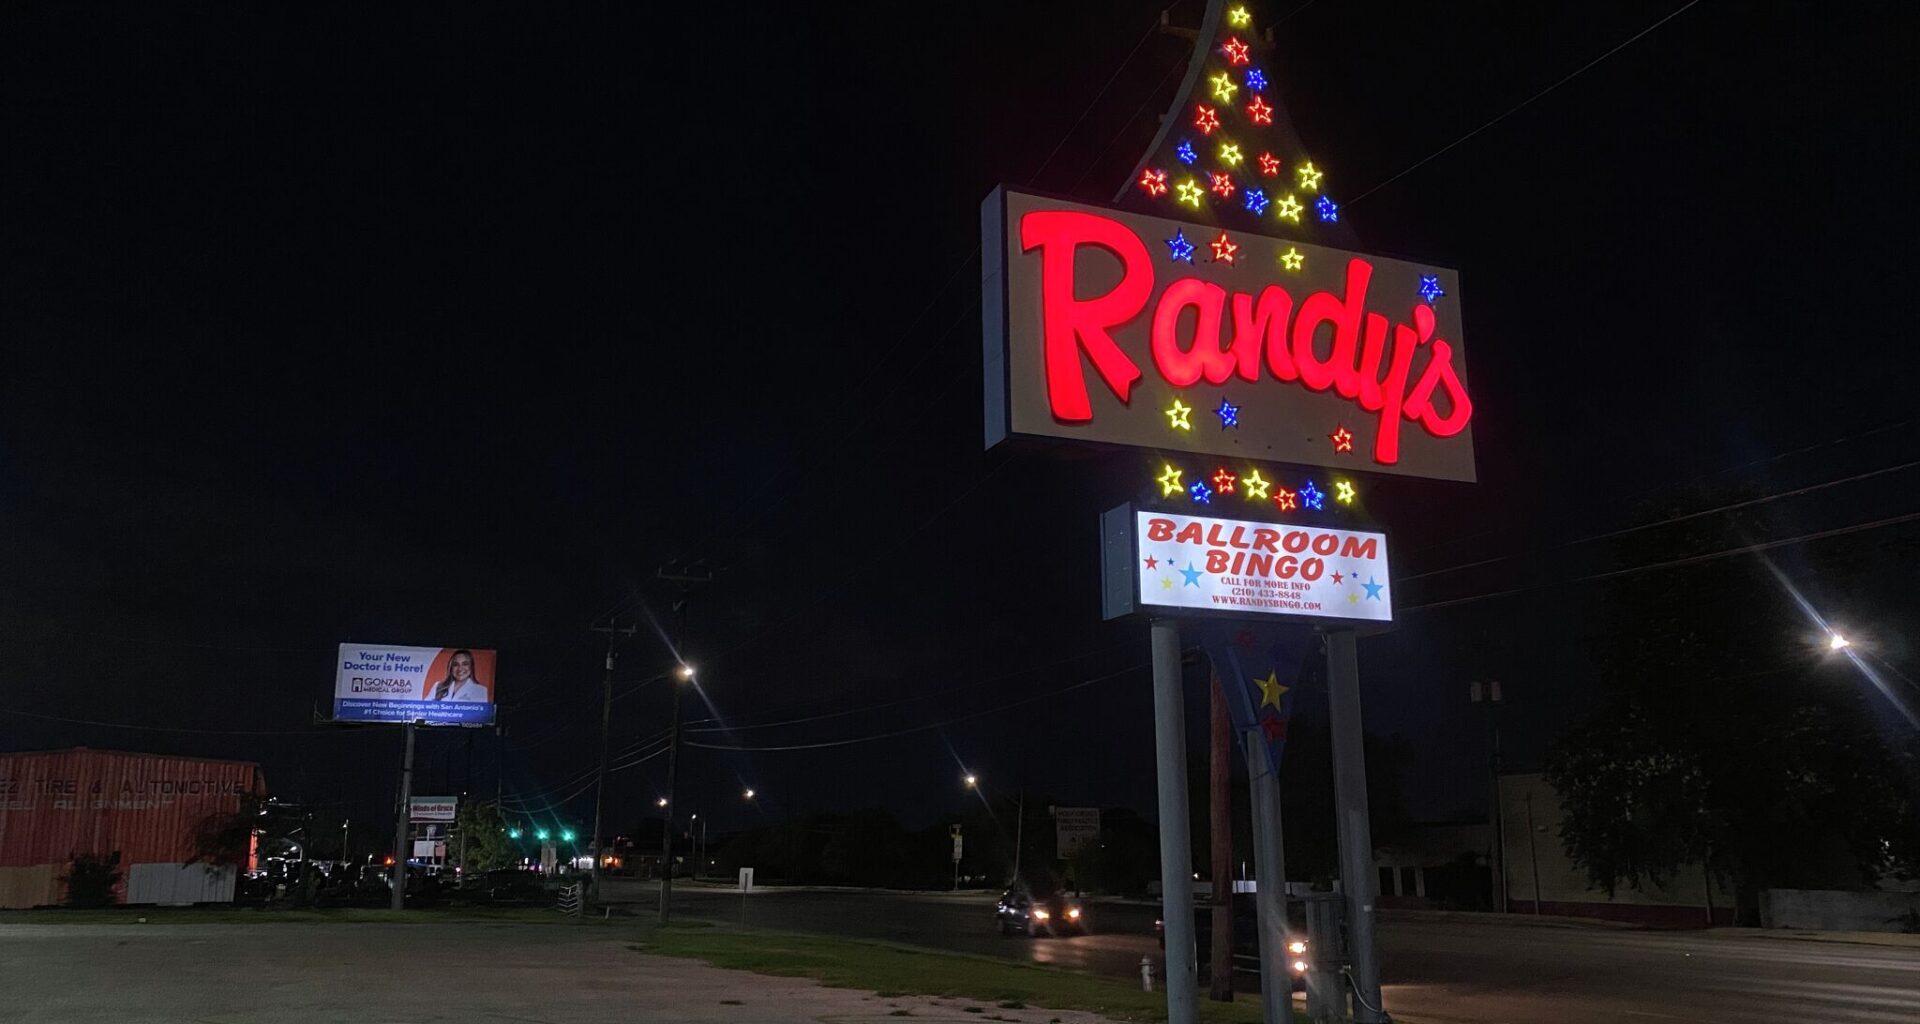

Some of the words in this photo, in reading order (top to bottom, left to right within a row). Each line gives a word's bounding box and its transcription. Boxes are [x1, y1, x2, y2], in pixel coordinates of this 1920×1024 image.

[1020, 210, 1473, 464] Randy's
[1146, 518, 1377, 560] BALLROOM
[1205, 549, 1325, 581] BINGO
[1220, 577, 1241, 586] CALL
[1243, 579, 1261, 587] FOR
[1264, 580, 1289, 589] MORE
[1291, 582, 1311, 591] INFO
[1231, 588, 1255, 597] (210)
[1257, 590, 1301, 599] 433-8848
[1212, 595, 1321, 610] WWW.RANDYSBINGO.COM
[359, 651, 383, 661] Your
[386, 653, 411, 662] New
[344, 661, 380, 671] Doctor
[383, 663, 392, 671] is
[394, 664, 423, 673] Here!
[364, 678, 412, 687] GONZABA
[389, 702, 425, 711] Beginnings
[34, 779, 77, 794] TIRE
